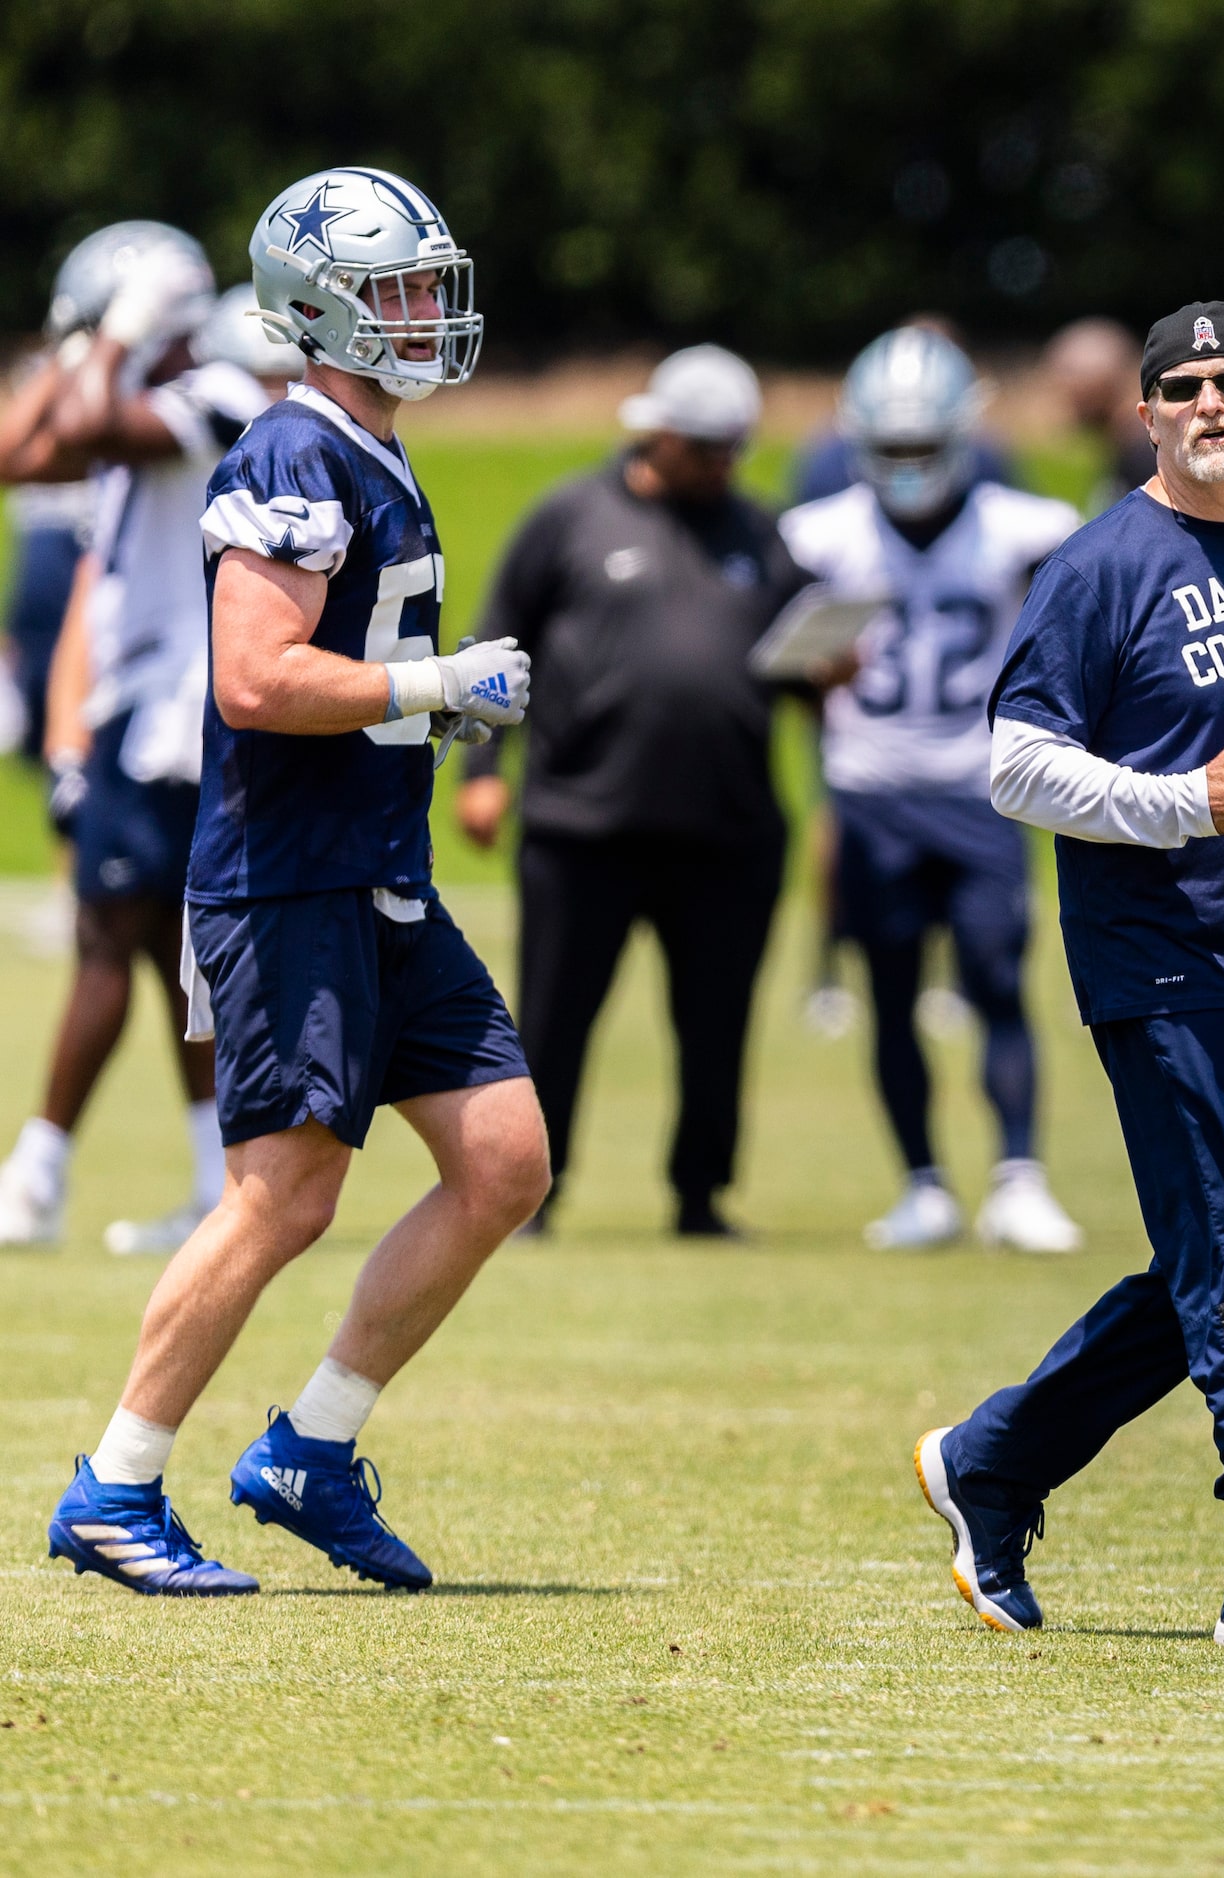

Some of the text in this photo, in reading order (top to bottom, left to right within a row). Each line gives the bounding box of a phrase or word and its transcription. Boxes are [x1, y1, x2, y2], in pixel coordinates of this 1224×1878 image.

[471, 685, 511, 708] adidas
[1155, 975, 1184, 984] DRI-FIT
[261, 1466, 303, 1512] adidas
